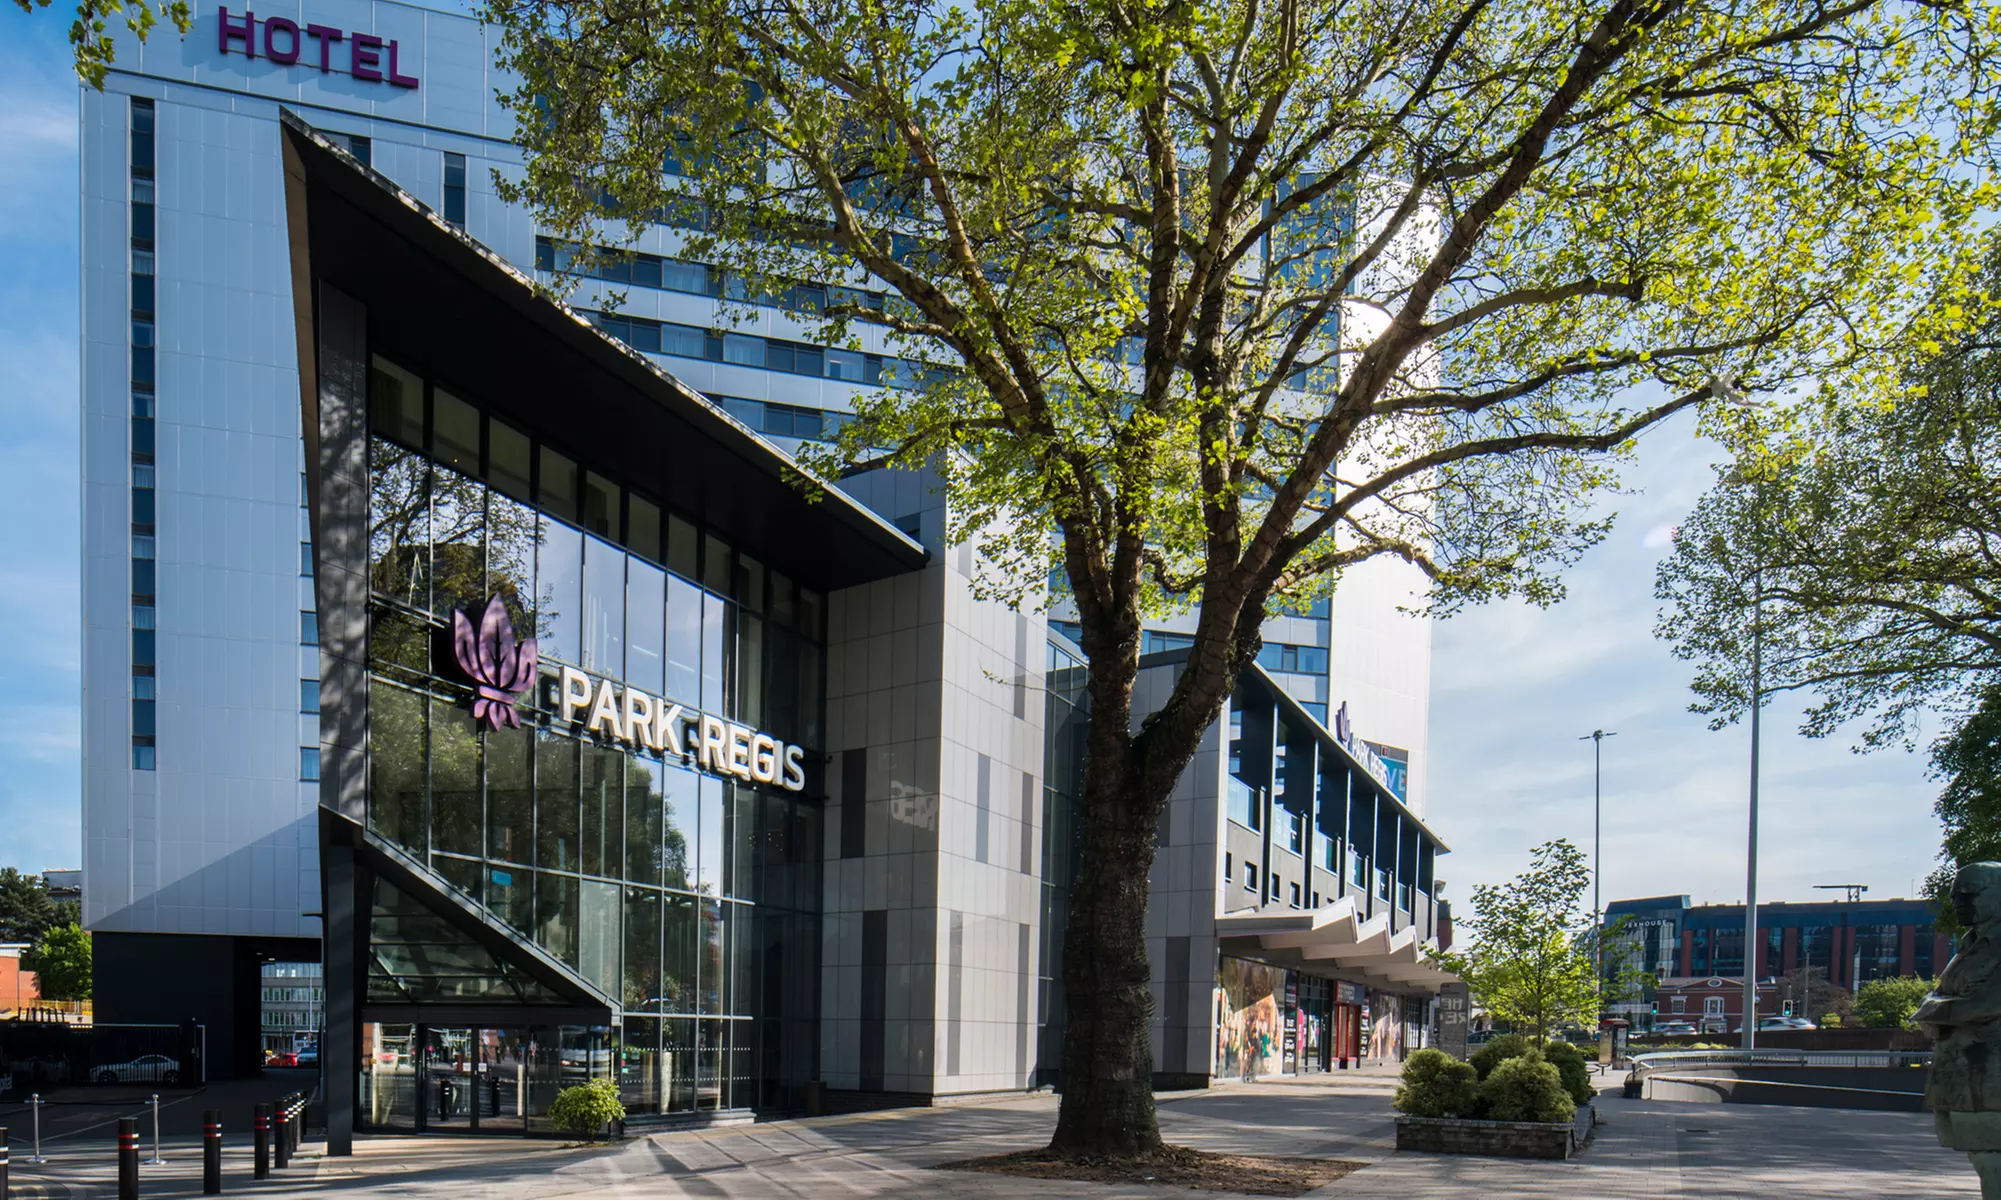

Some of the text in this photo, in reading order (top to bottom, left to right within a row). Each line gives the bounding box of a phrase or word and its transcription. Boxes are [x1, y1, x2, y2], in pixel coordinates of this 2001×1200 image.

[219, 6, 419, 89] HOTEL
[559, 664, 805, 791] PARK REGIS
